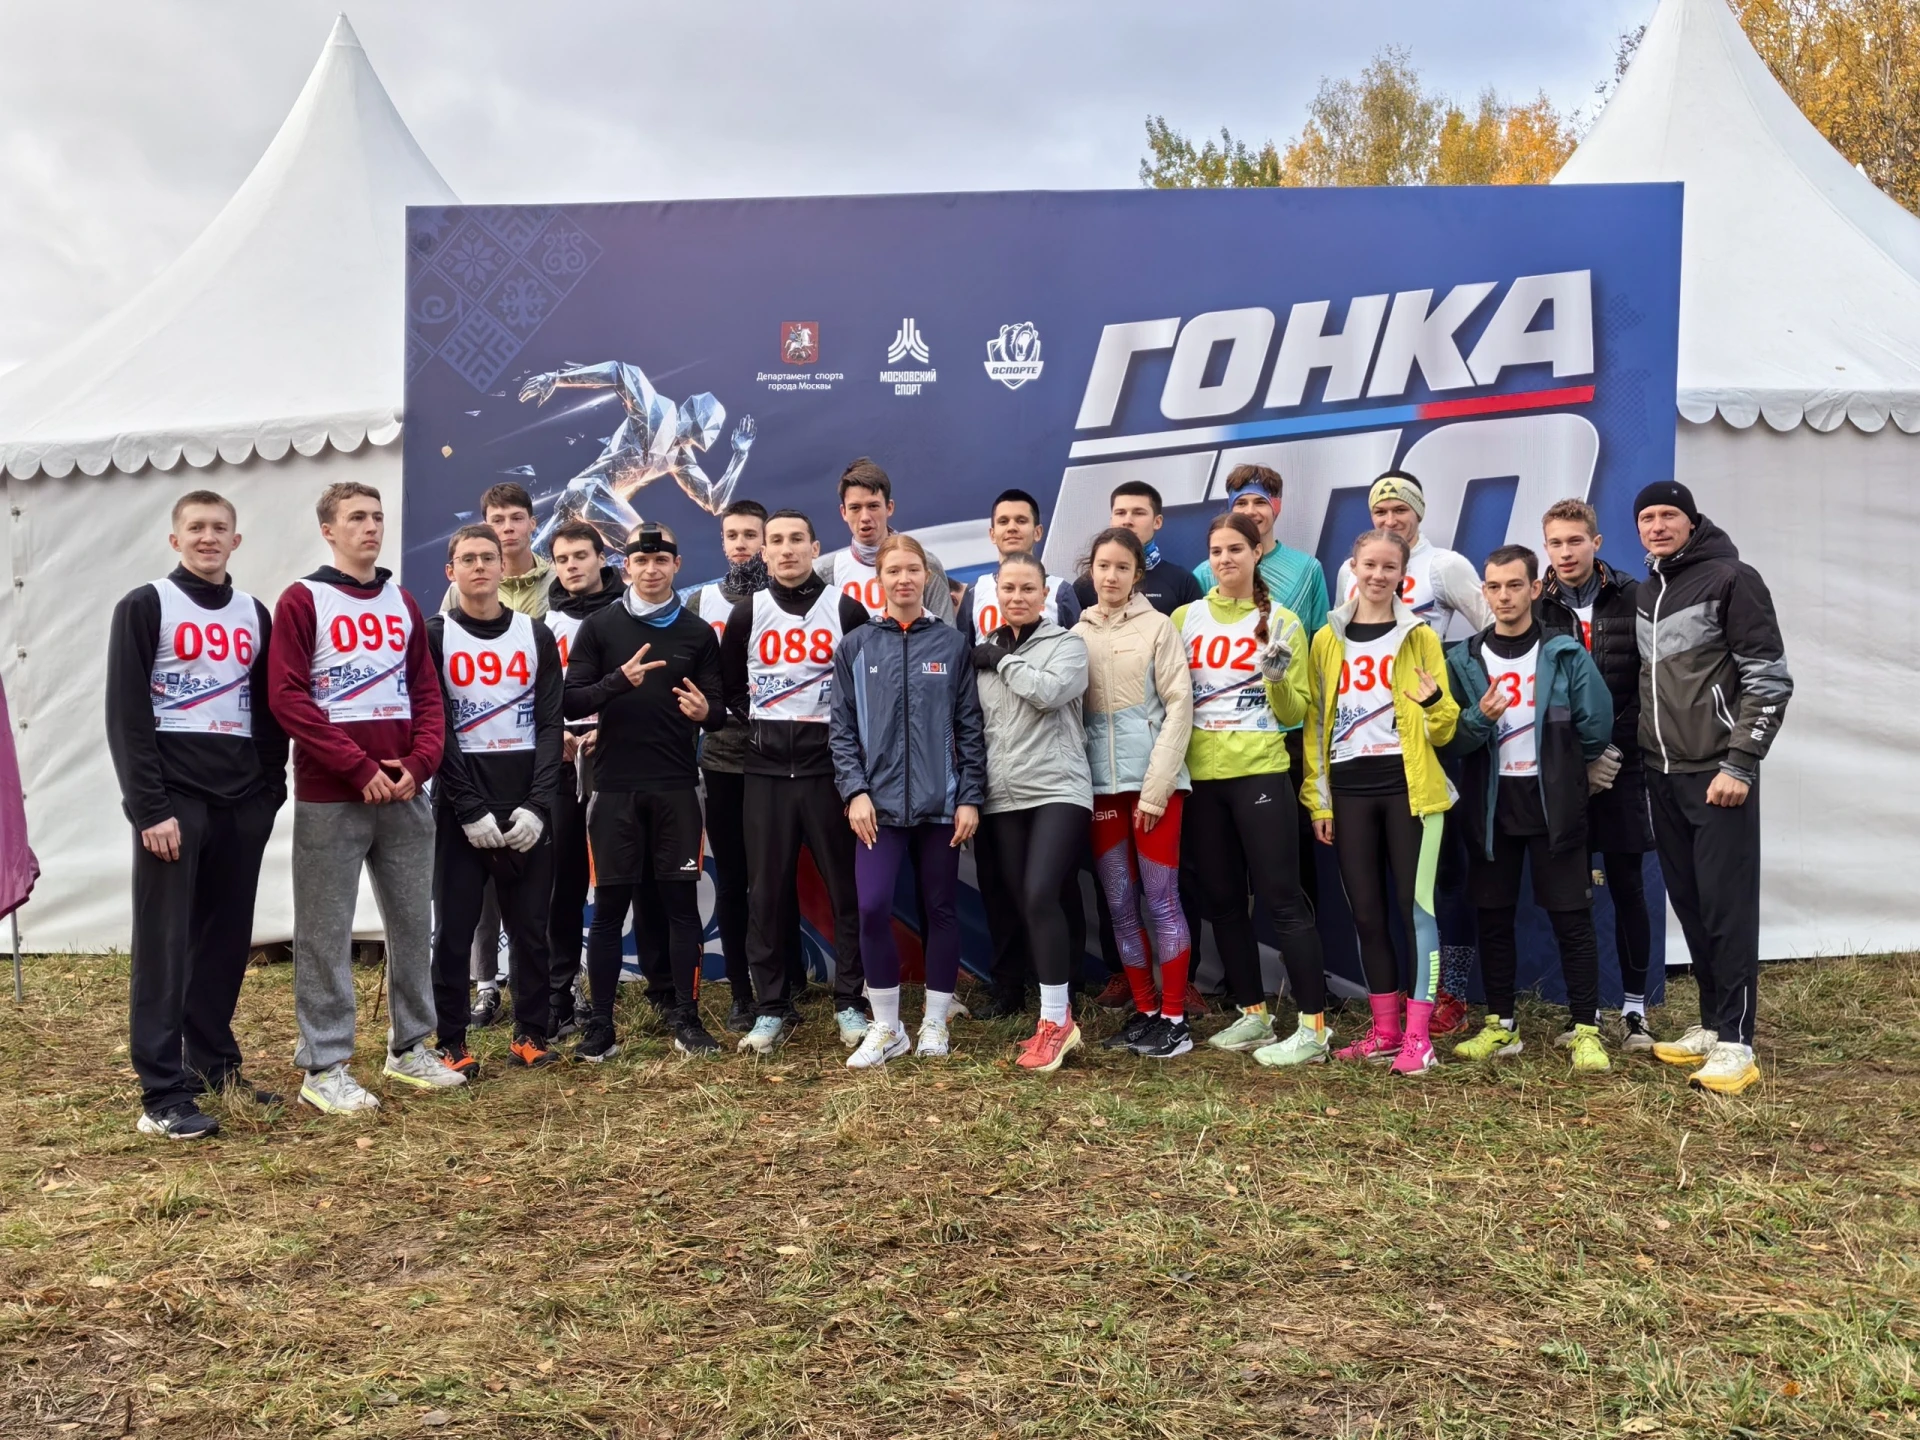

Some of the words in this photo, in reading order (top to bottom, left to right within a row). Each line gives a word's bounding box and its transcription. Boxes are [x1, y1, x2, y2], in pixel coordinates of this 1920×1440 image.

[1075, 269, 1594, 429] ГОНКА
[757, 372, 811, 381] Департамент
[815, 373, 844, 381] спорта
[768, 383, 797, 391] города
[799, 382, 831, 390] Москвы
[880, 369, 936, 382] МОСКОВСКИЙ
[992, 366, 1037, 374] ВСПОРТЕ
[895, 384, 921, 395] СПОРТ
[843, 577, 887, 609] 00
[174, 622, 252, 665] 096
[331, 612, 405, 652] 095
[759, 628, 833, 665] 088
[449, 651, 531, 687] 094
[1189, 634, 1257, 671] 102
[1489, 672, 1536, 707] 31
[1427, 950, 1440, 994] PUMA
